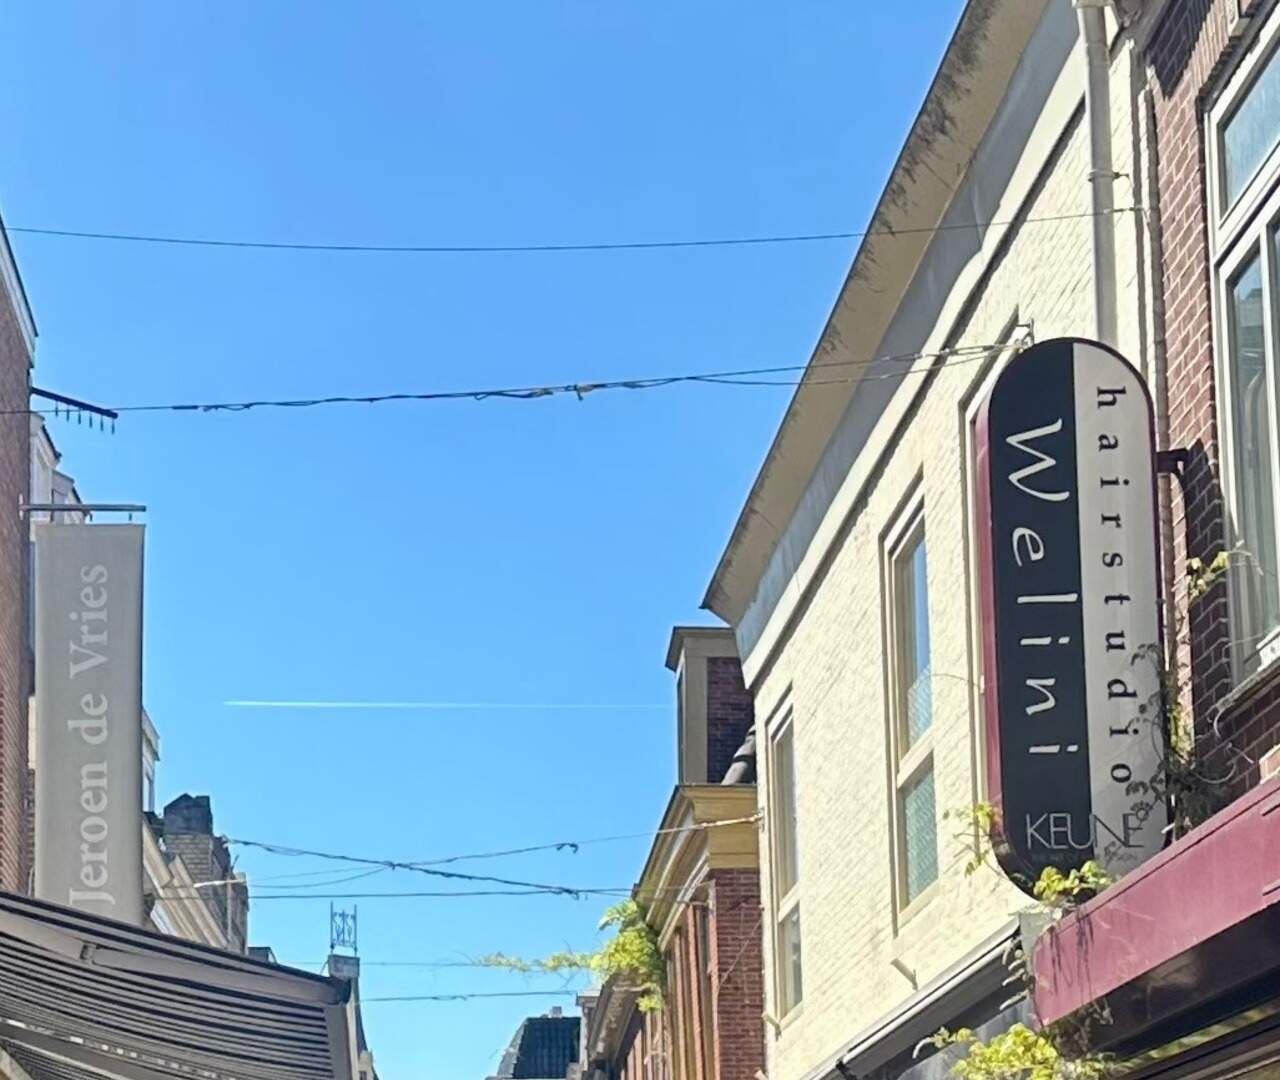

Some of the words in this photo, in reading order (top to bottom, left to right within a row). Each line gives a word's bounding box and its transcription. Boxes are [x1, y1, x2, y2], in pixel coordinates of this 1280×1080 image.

[69, 563, 109, 678] Vries
[1005, 418, 1079, 754] Welini
[1096, 386, 1139, 784] hairstudio
[67, 693, 108, 745] de
[70, 761, 116, 907] Jeroen
[1026, 812, 1145, 850] KEUNE
